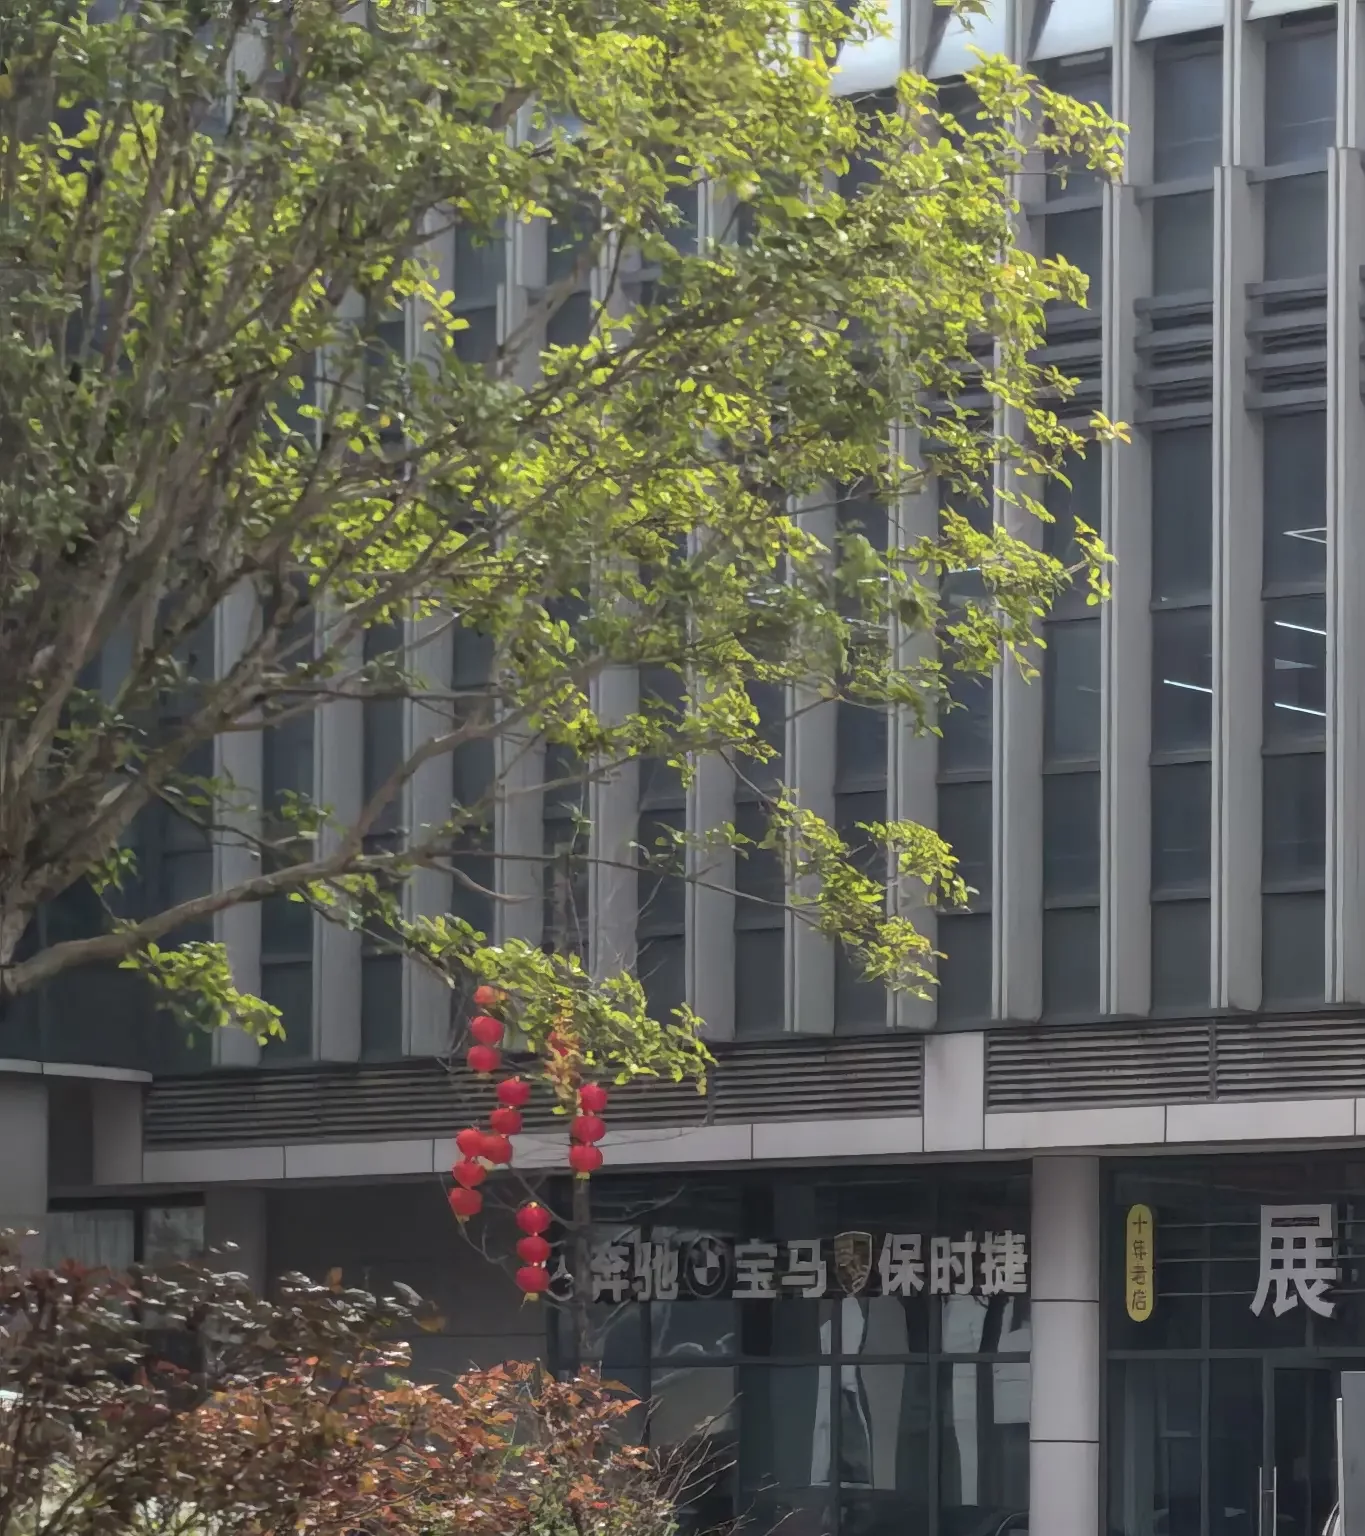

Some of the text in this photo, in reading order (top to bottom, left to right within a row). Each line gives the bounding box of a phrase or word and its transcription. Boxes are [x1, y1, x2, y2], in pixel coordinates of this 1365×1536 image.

[591, 1230, 1028, 1302] 奔驰 宝马 保时捷
[1131, 1211, 1148, 1312] 十年老店
